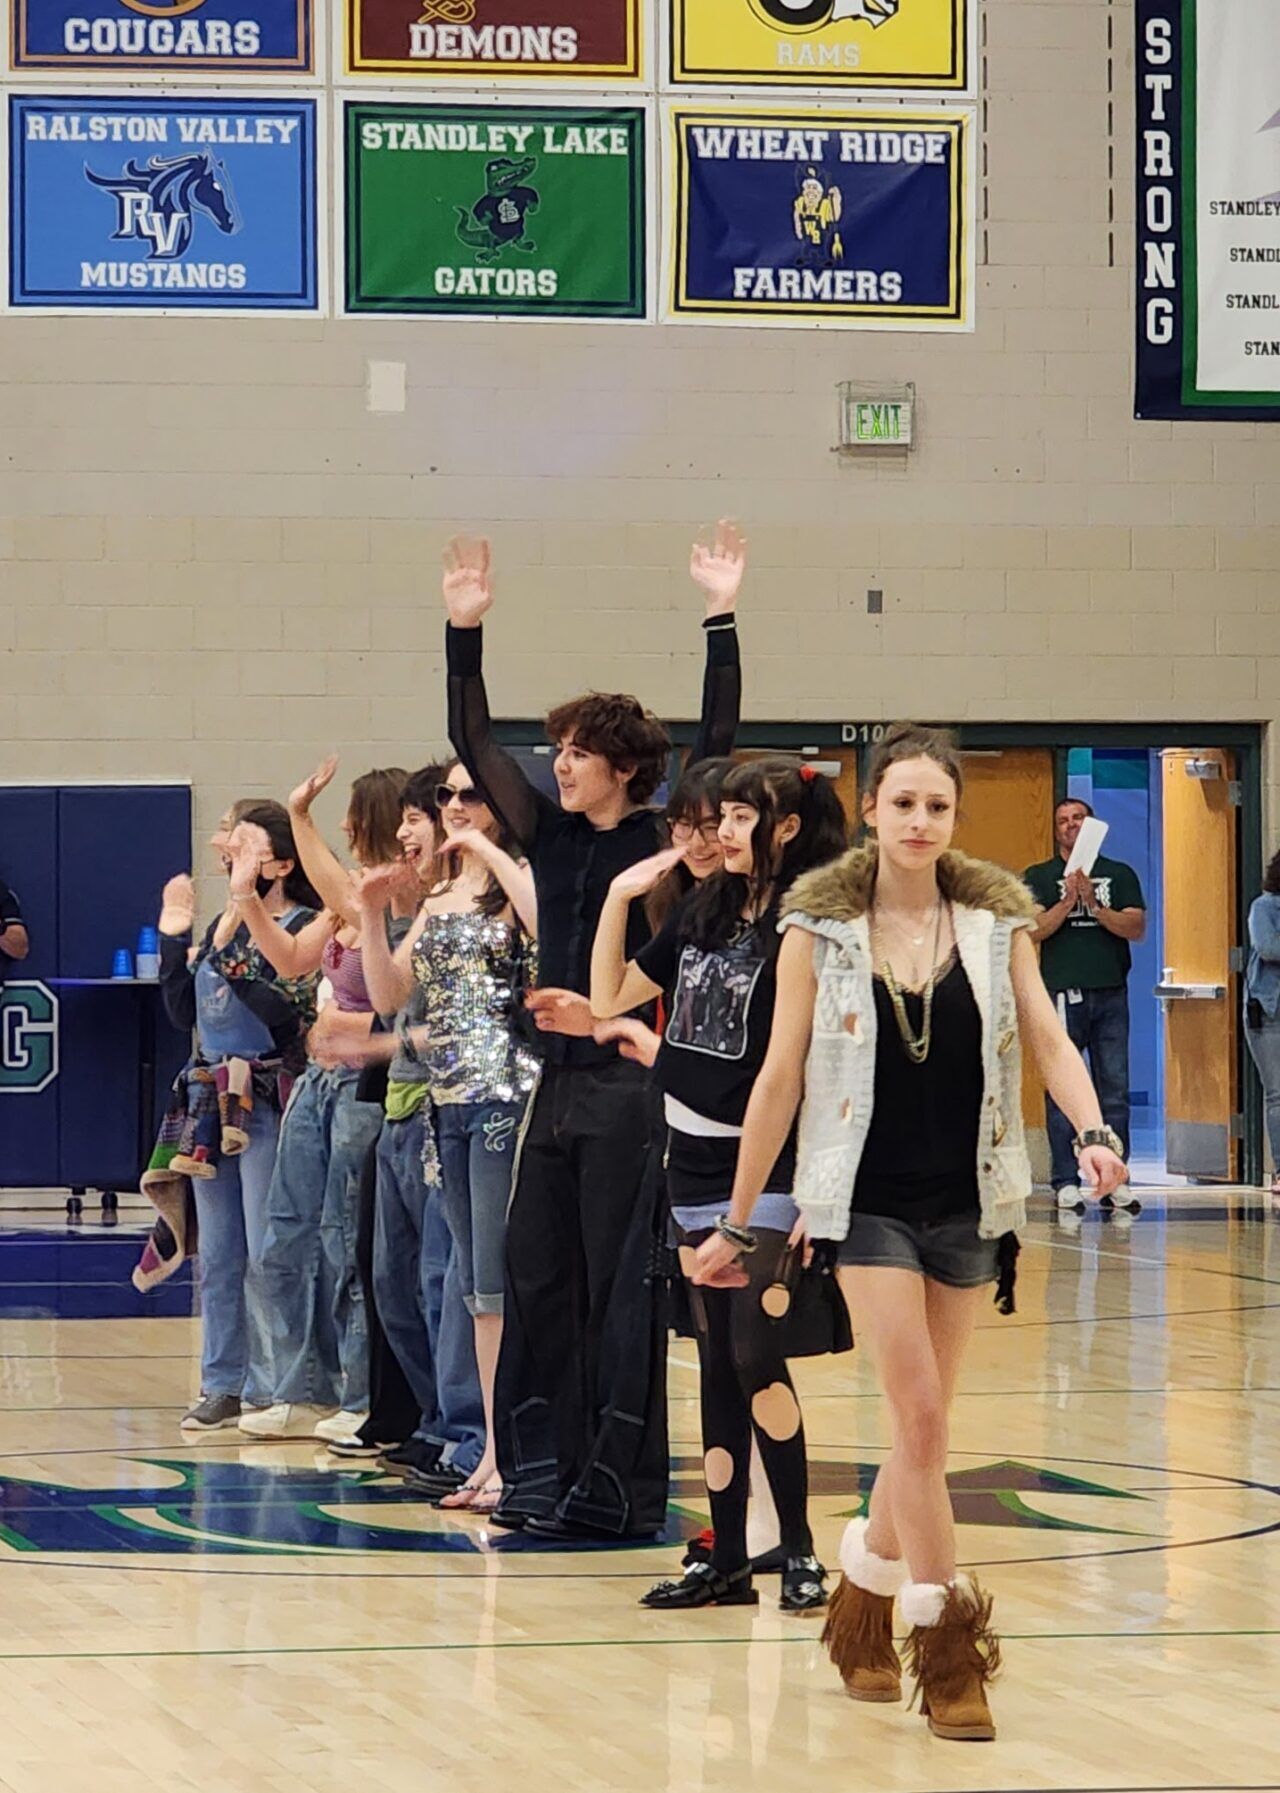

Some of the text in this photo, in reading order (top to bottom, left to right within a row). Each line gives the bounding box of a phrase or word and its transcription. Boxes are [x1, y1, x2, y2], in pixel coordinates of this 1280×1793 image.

[63, 18, 261, 55] COUGARS
[409, 23, 578, 61] DEMONS
[776, 41, 861, 67] RAMS
[26, 115, 299, 145] RALSTON VALLEY
[362, 121, 629, 155] STANDLEY LAKE
[692, 128, 947, 165] WHEAT RIDGE
[1144, 18, 1175, 344] STRONG
[1209, 201, 1280, 216] STANDLEY
[80, 261, 247, 290] MUSTANGS
[434, 266, 558, 297] GATORS
[733, 267, 903, 303] FARMERS
[856, 403, 902, 440] EXIT
[841, 723, 892, 744] D10
